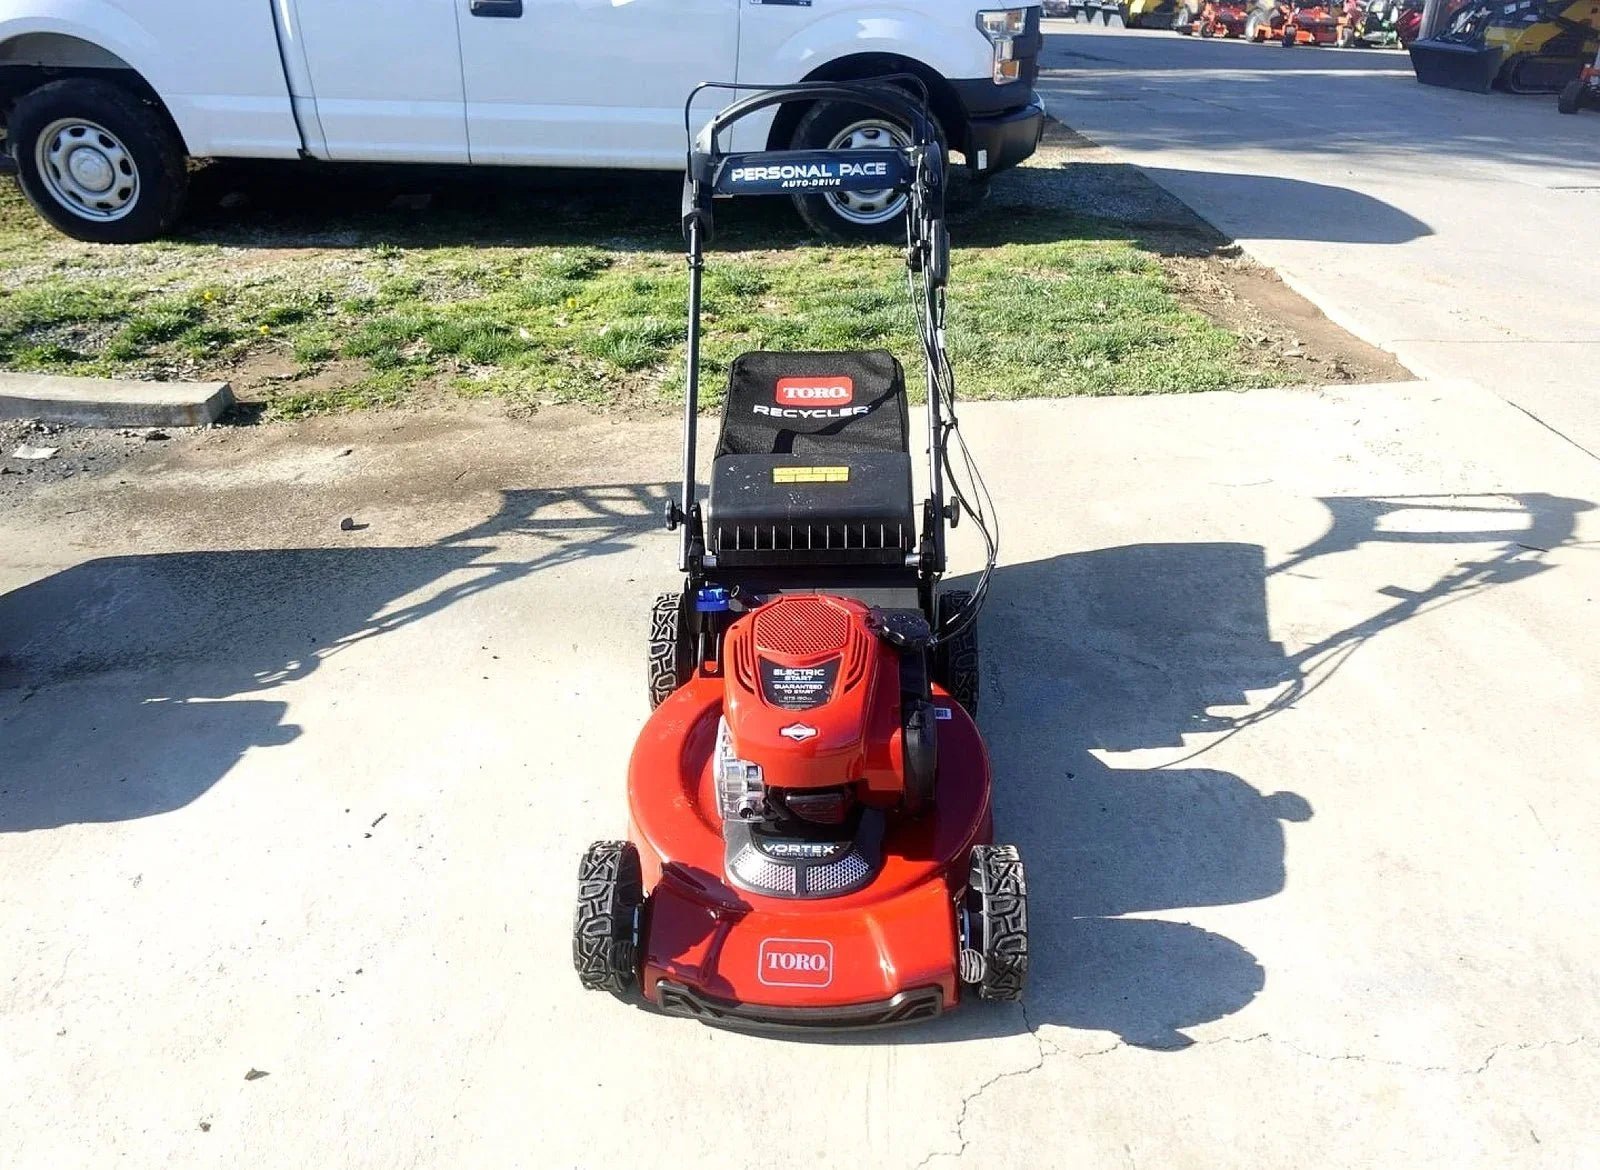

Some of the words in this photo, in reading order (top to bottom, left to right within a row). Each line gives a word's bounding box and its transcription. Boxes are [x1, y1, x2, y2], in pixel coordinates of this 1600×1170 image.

[731, 164, 832, 181] PERSONAL
[839, 162, 888, 176] PACE
[781, 179, 841, 188] AUTO-DRIVE
[783, 387, 848, 399] TORO
[753, 404, 869, 418] RECYCLER
[773, 668, 825, 676] ELECTRIC
[762, 844, 836, 854] VORTEX
[766, 952, 827, 971] TORO
